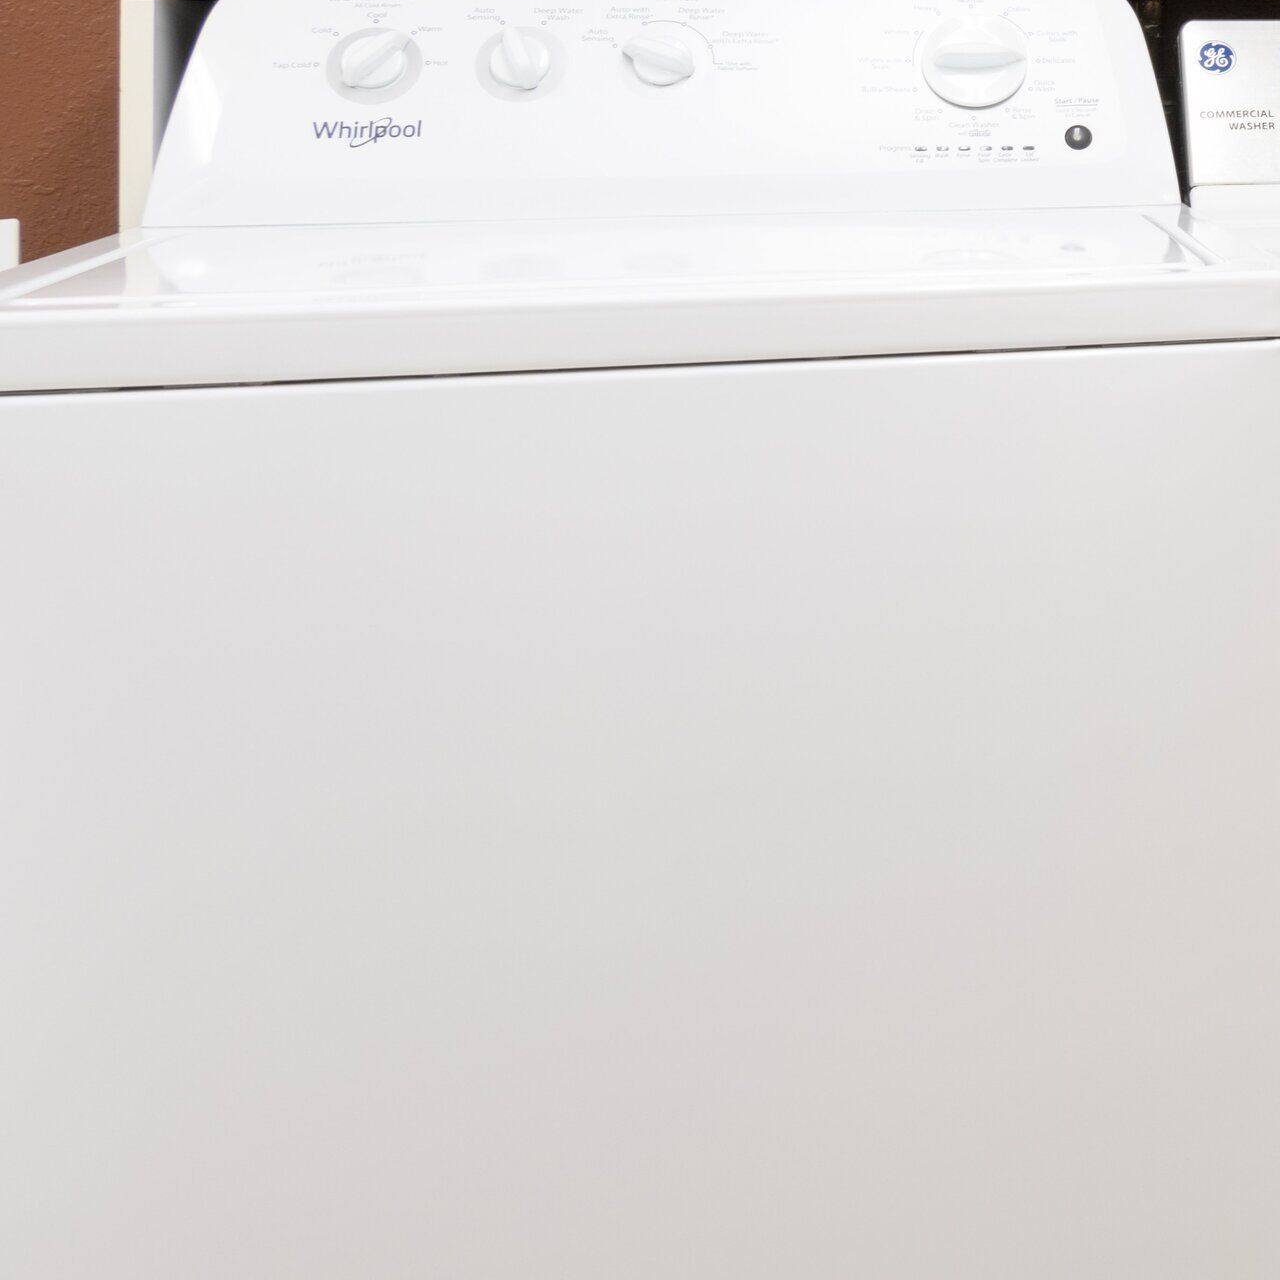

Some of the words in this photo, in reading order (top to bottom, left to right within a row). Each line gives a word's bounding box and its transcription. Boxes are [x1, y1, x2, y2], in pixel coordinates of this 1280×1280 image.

[1200, 110, 1275, 119] COMMERCIAL
[1229, 122, 1275, 130] WASHER
[313, 119, 422, 144] Whirlpool
